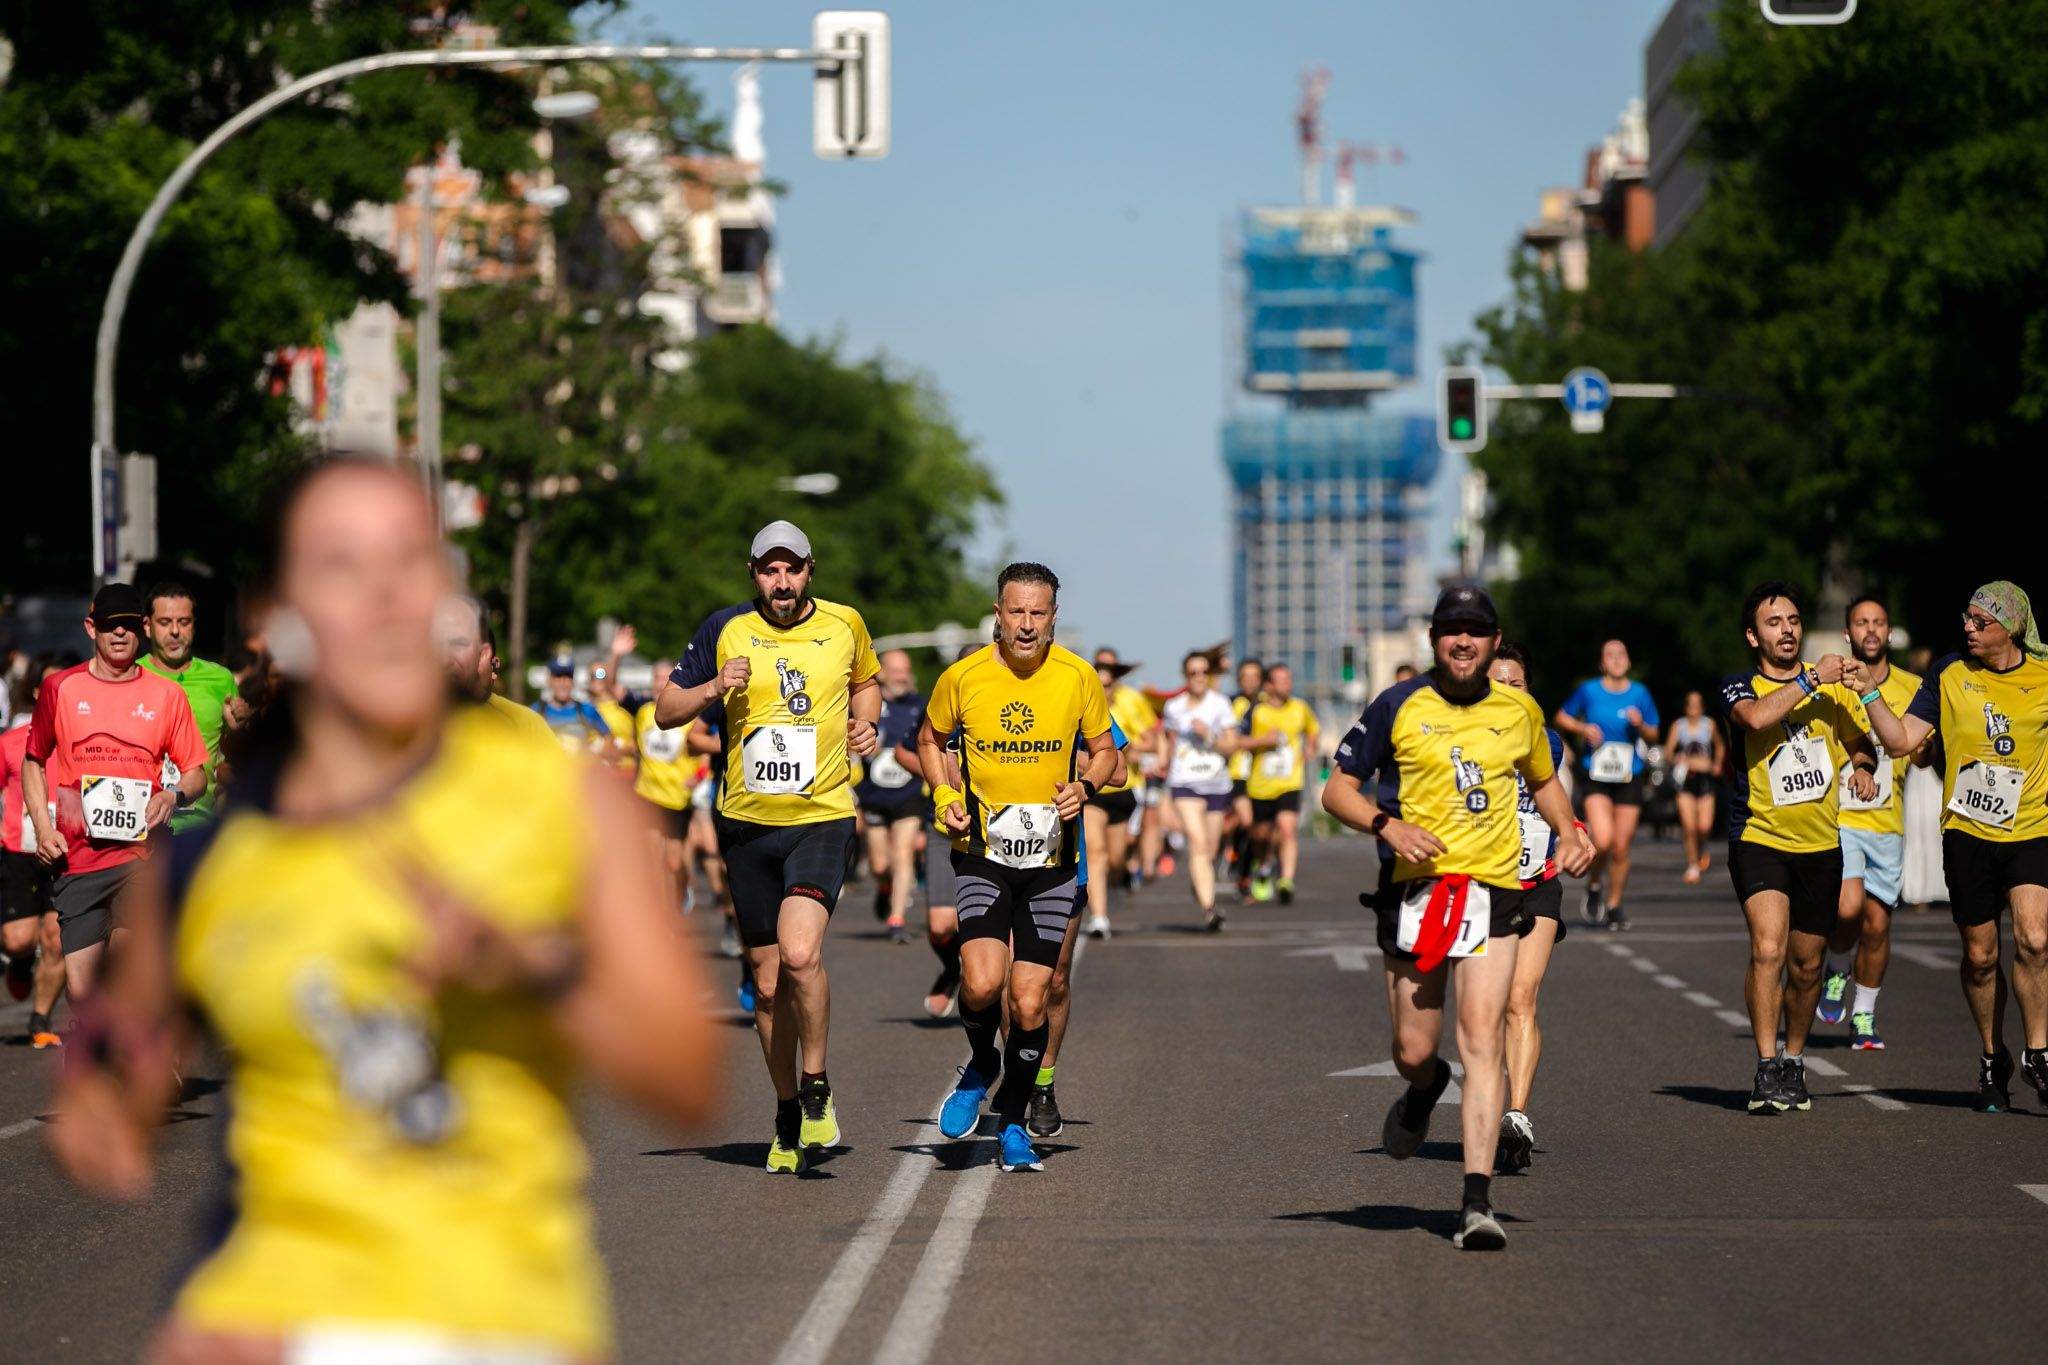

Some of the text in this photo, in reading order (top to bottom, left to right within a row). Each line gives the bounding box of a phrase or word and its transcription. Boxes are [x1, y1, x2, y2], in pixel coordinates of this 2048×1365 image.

[792, 697, 807, 711] 13
[85, 746, 103, 754] MID
[1997, 740, 2011, 752] 13
[1000, 755, 1040, 764] SPORTS
[755, 760, 801, 782] 2091
[1782, 769, 1825, 793] 3930
[1469, 794, 1487, 809] 13
[1966, 788, 2004, 815] 1852
[92, 808, 137, 830] 2865
[1002, 838, 1045, 858] 3012
